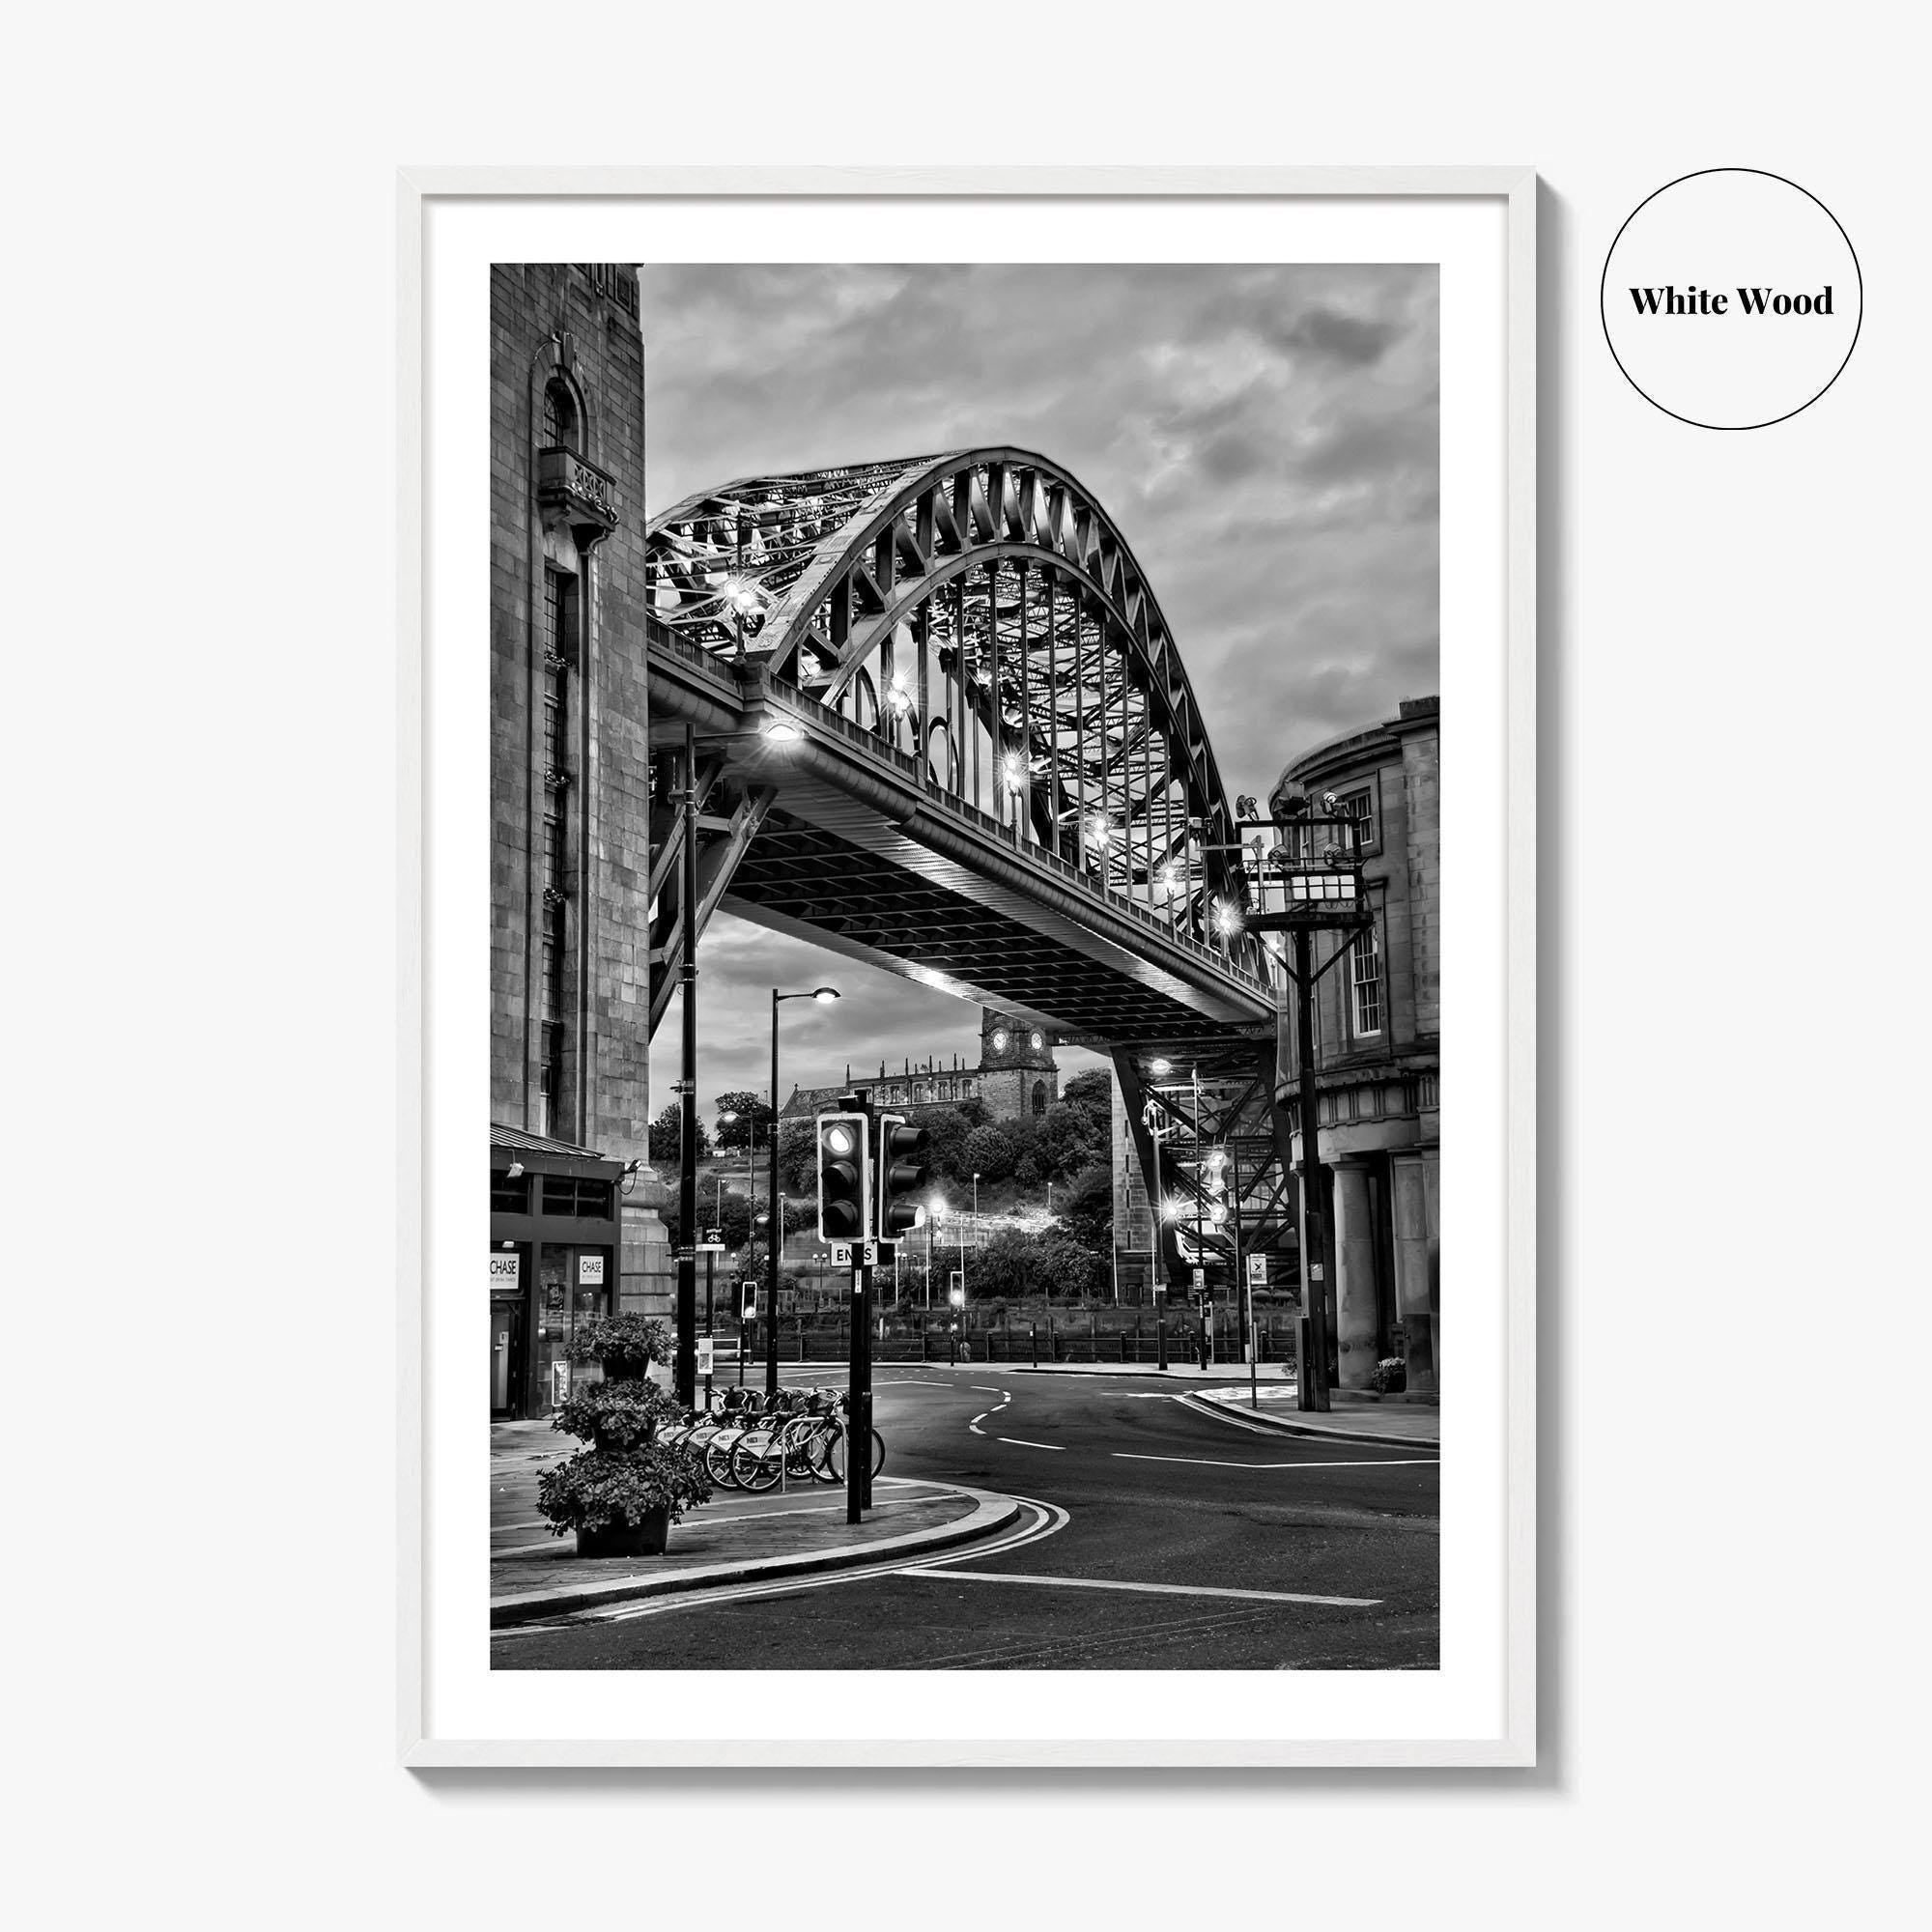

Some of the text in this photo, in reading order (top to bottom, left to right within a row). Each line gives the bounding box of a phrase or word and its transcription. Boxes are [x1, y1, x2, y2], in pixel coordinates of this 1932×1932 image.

[837, 1248, 872, 1261] ENS
[490, 1260, 517, 1274] CHASE
[582, 1261, 602, 1273] CHASE
